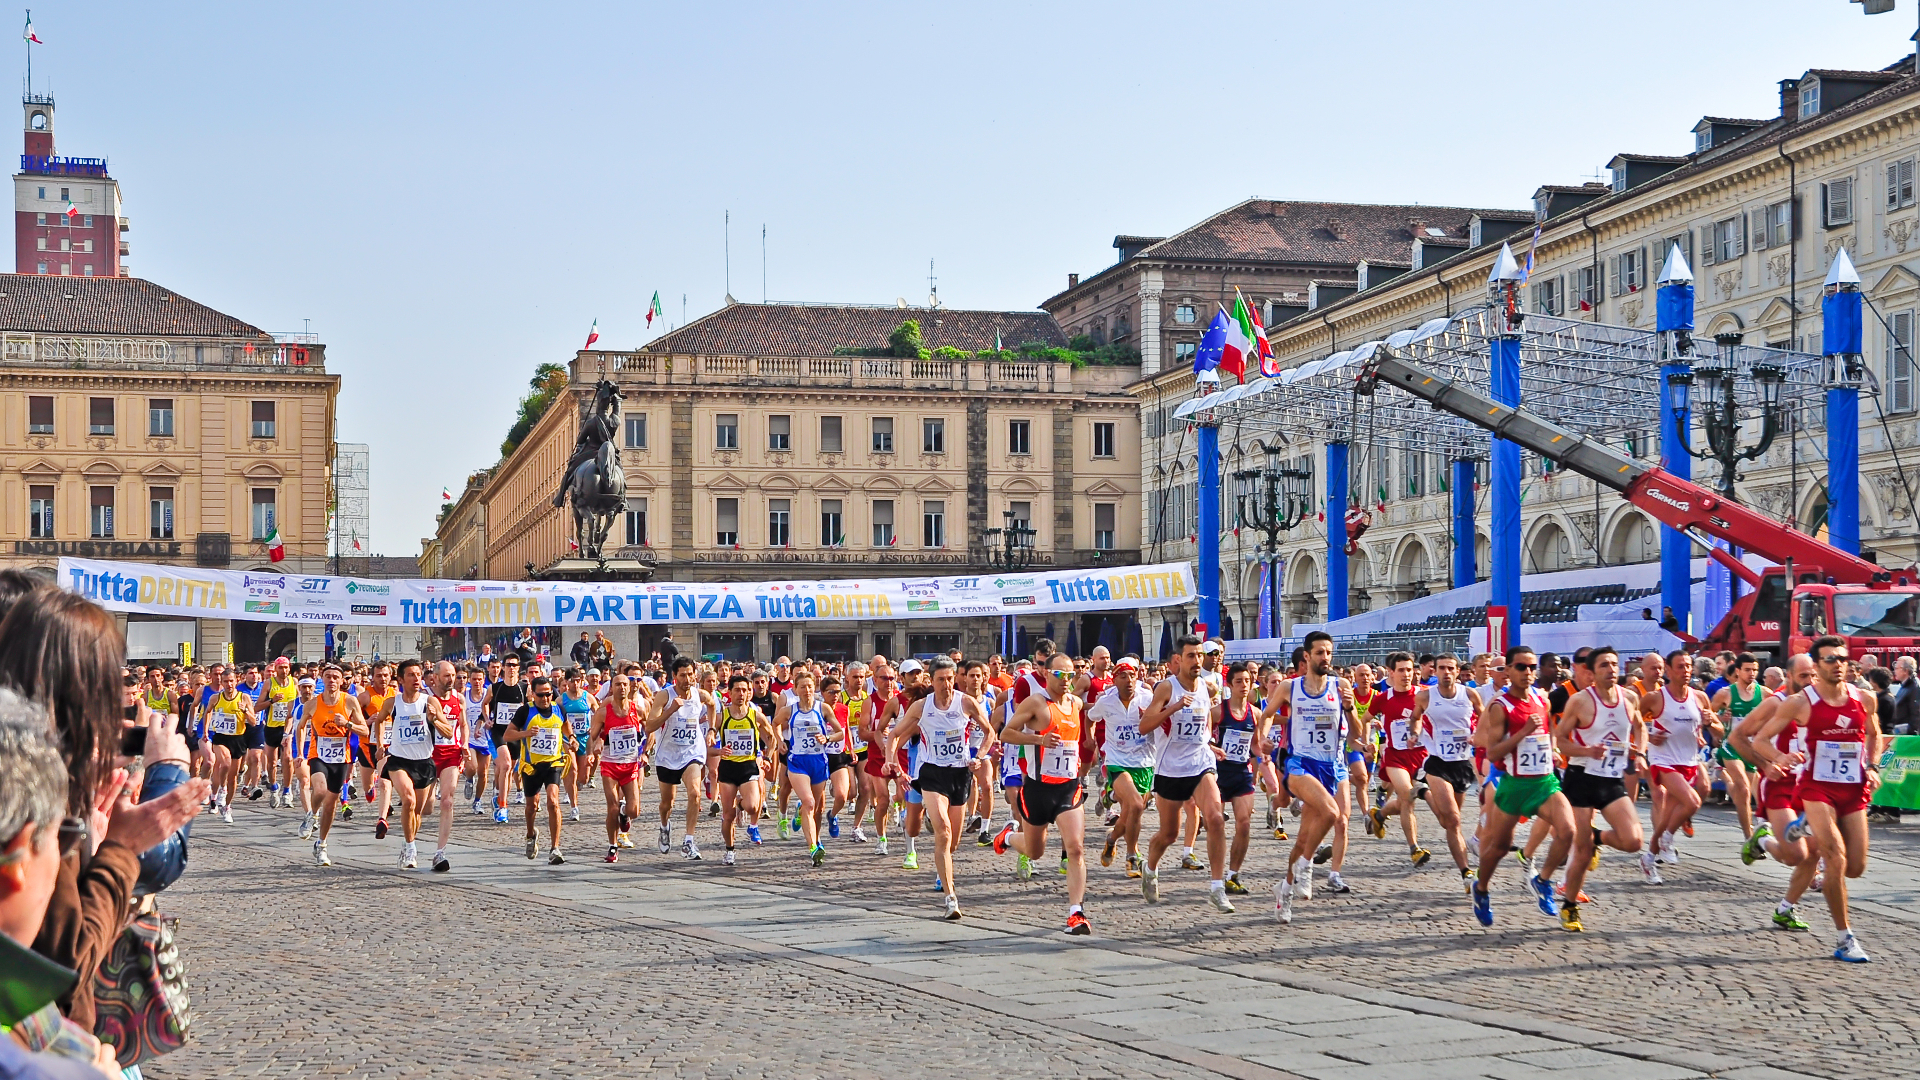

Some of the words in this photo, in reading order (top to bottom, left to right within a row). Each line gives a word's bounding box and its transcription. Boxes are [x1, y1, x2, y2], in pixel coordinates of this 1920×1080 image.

[20, 154, 60, 172] REALE
[64, 157, 108, 174] MUTUA
[1646, 488, 1689, 512] CORMACH
[15, 540, 182, 556] INDUSTRIALE
[756, 552, 824, 563] NAZIONALE
[832, 552, 869, 563] DELLE
[555, 594, 744, 622] PARTENZA
[960, 605, 998, 613] STAMPA
[301, 612, 343, 621] STAMPA
[1760, 622, 1779, 630] VIG
[215, 720, 236, 731] 2418
[398, 726, 426, 739] 1044
[672, 728, 697, 740] 2043
[1307, 731, 1327, 744] 13
[531, 738, 557, 750] 2329
[612, 738, 637, 751] 1310
[726, 740, 753, 751] 2868
[802, 738, 816, 749] 33
[933, 742, 964, 756] 1306
[1439, 742, 1468, 755] 1299
[319, 747, 345, 758] 1254
[1055, 756, 1070, 771] 11
[1601, 756, 1617, 769] 14
[1829, 759, 1850, 775] 15
